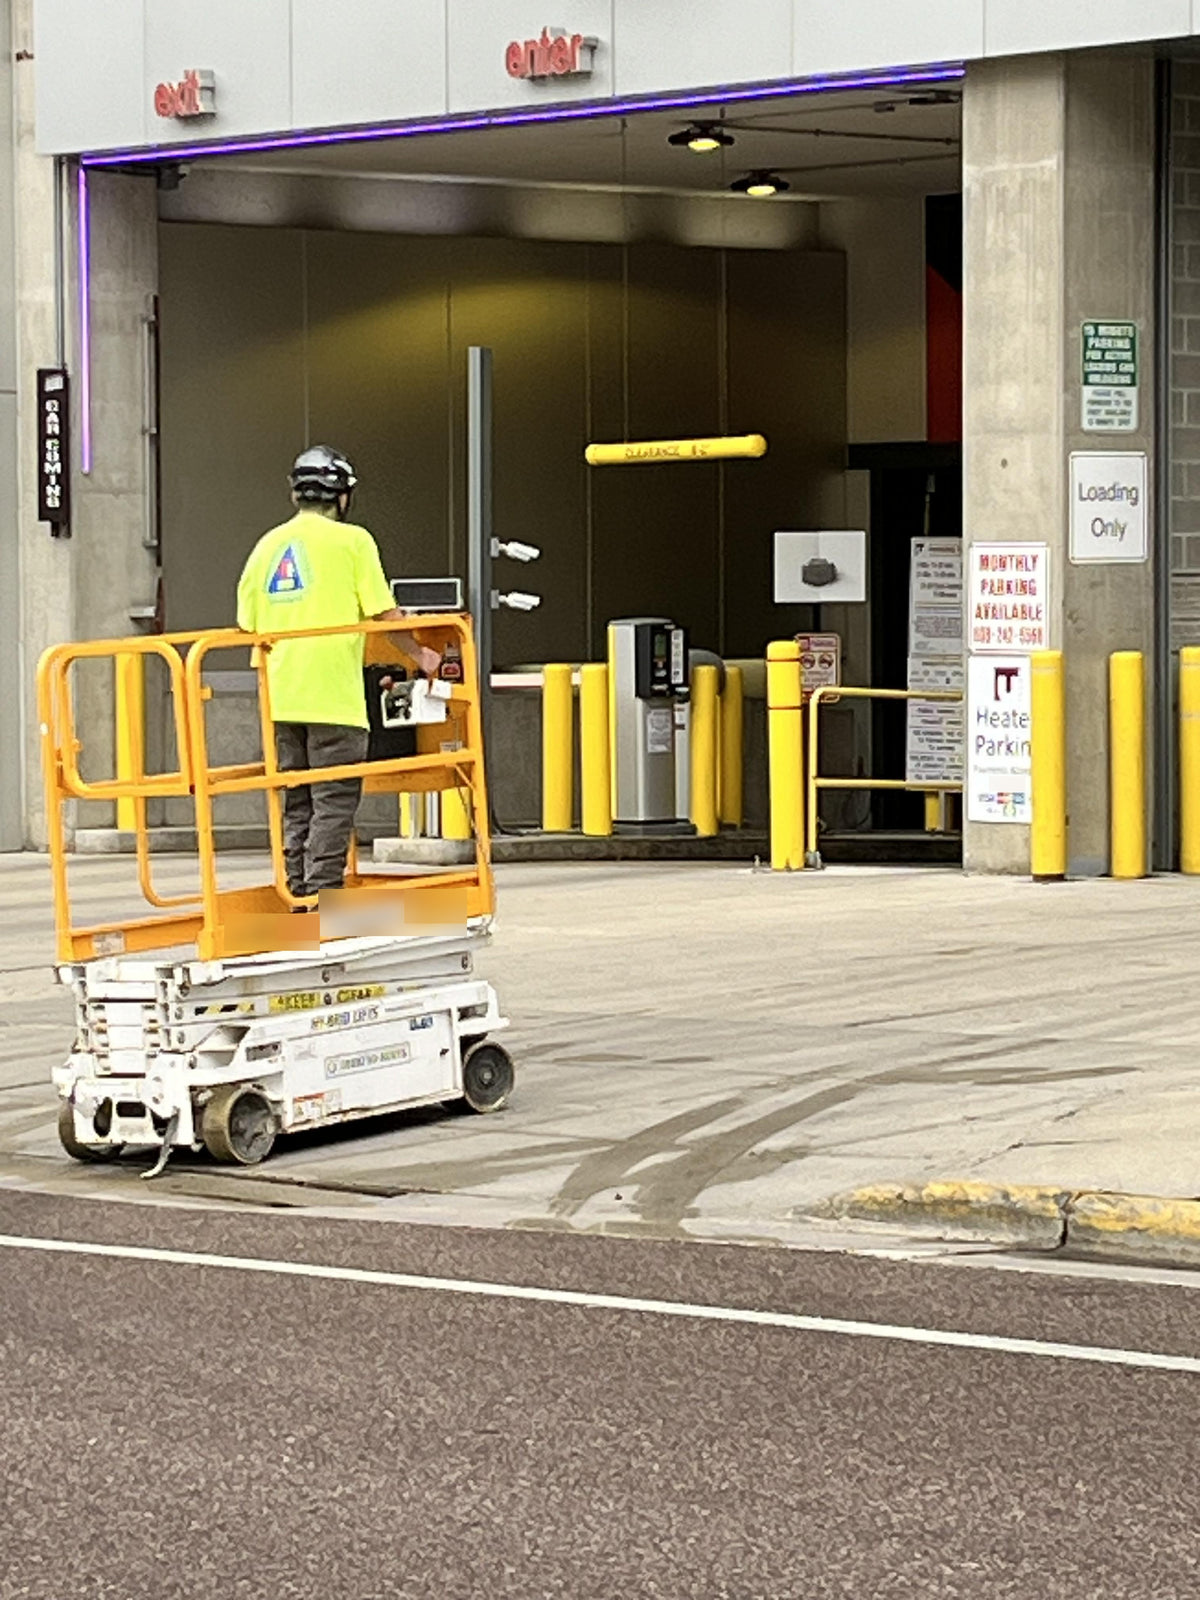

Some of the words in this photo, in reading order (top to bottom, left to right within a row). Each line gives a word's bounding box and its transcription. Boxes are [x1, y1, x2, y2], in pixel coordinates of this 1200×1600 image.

[506, 26, 583, 79] enter
[154, 68, 202, 118] exit
[44, 438, 61, 508] COMING
[1078, 482, 1139, 506] Loading
[1091, 516, 1127, 542] Only
[979, 554, 1039, 572] MONTHLY
[980, 578, 1037, 596] PARKING
[975, 602, 1043, 621] AVAILABLE
[976, 705, 1031, 729] Heate
[975, 734, 1032, 757] Parkin
